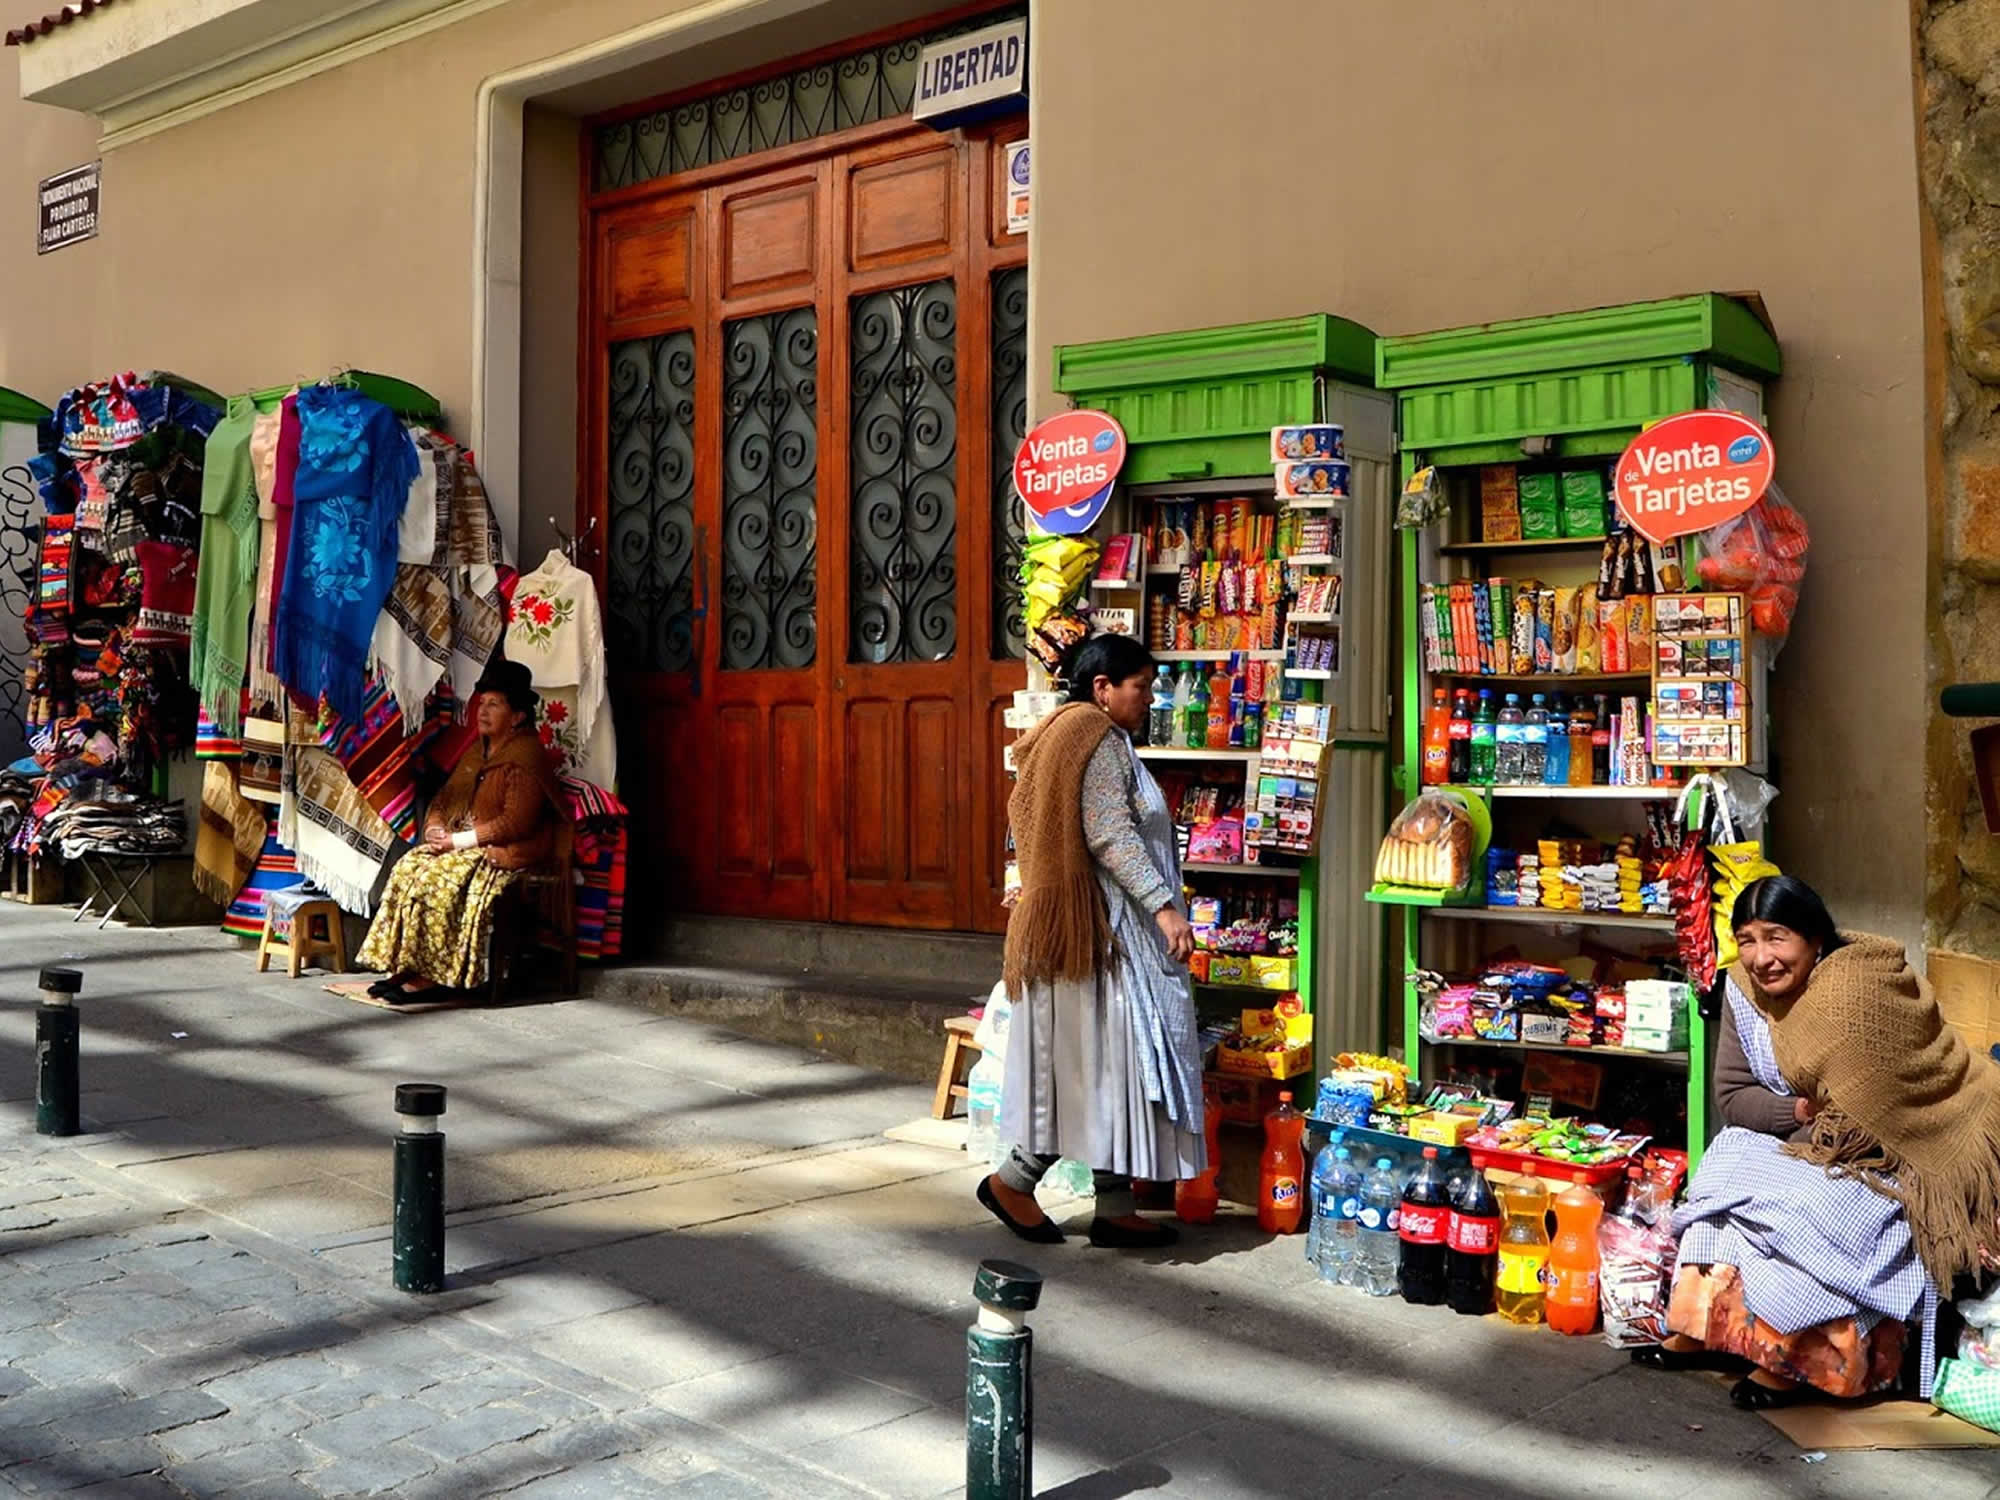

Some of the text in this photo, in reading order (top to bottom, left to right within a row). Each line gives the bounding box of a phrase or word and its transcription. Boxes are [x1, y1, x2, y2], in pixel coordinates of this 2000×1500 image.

[921, 35, 1020, 99] LIBERTAD
[50, 196, 89, 223] PROHIBIDO
[62, 212, 95, 237] CARTELES
[1021, 459, 1031, 468] de
[1029, 435, 1088, 464] Venta
[1635, 442, 1721, 477] Venta
[1022, 463, 1108, 495] Tarjetas
[1624, 471, 1640, 483] de
[1629, 477, 1751, 516] Tarjetas
